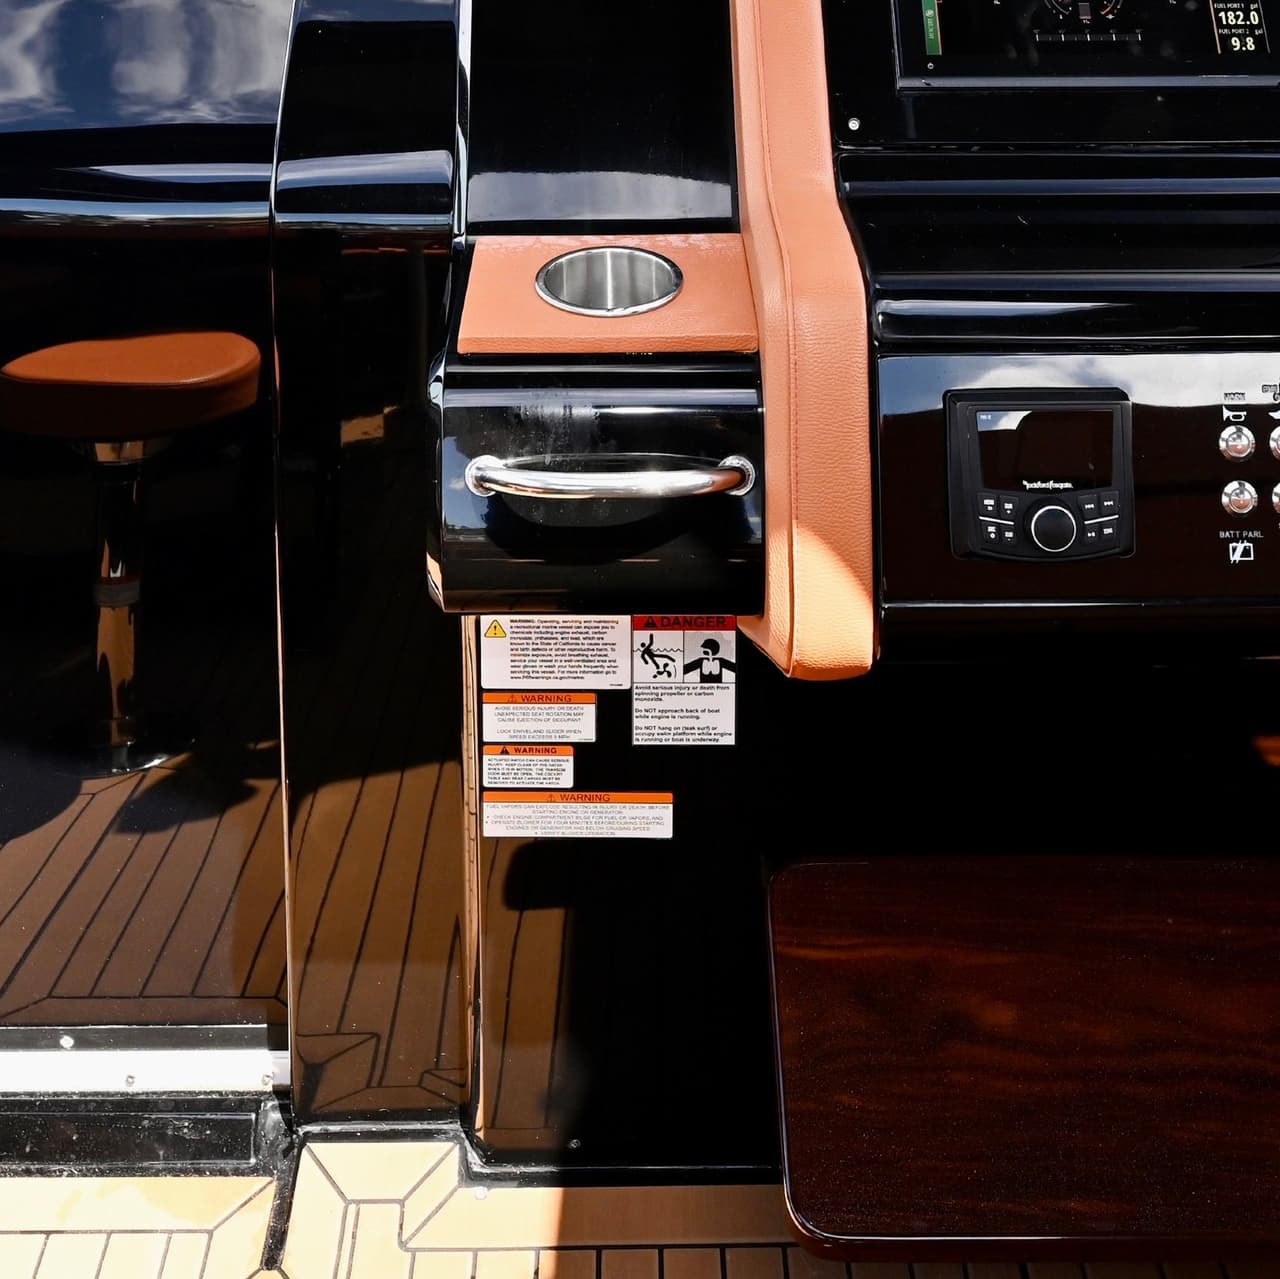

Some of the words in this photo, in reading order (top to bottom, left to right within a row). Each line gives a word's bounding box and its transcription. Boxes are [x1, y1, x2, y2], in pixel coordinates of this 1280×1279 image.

[1218, 10, 1259, 25] 182.0
[1231, 36, 1256, 51] 9.8
[660, 616, 726, 627] DANGER
[521, 694, 572, 703] WARNING
[513, 746, 557, 754] WARNING
[560, 793, 611, 802] WARNING
